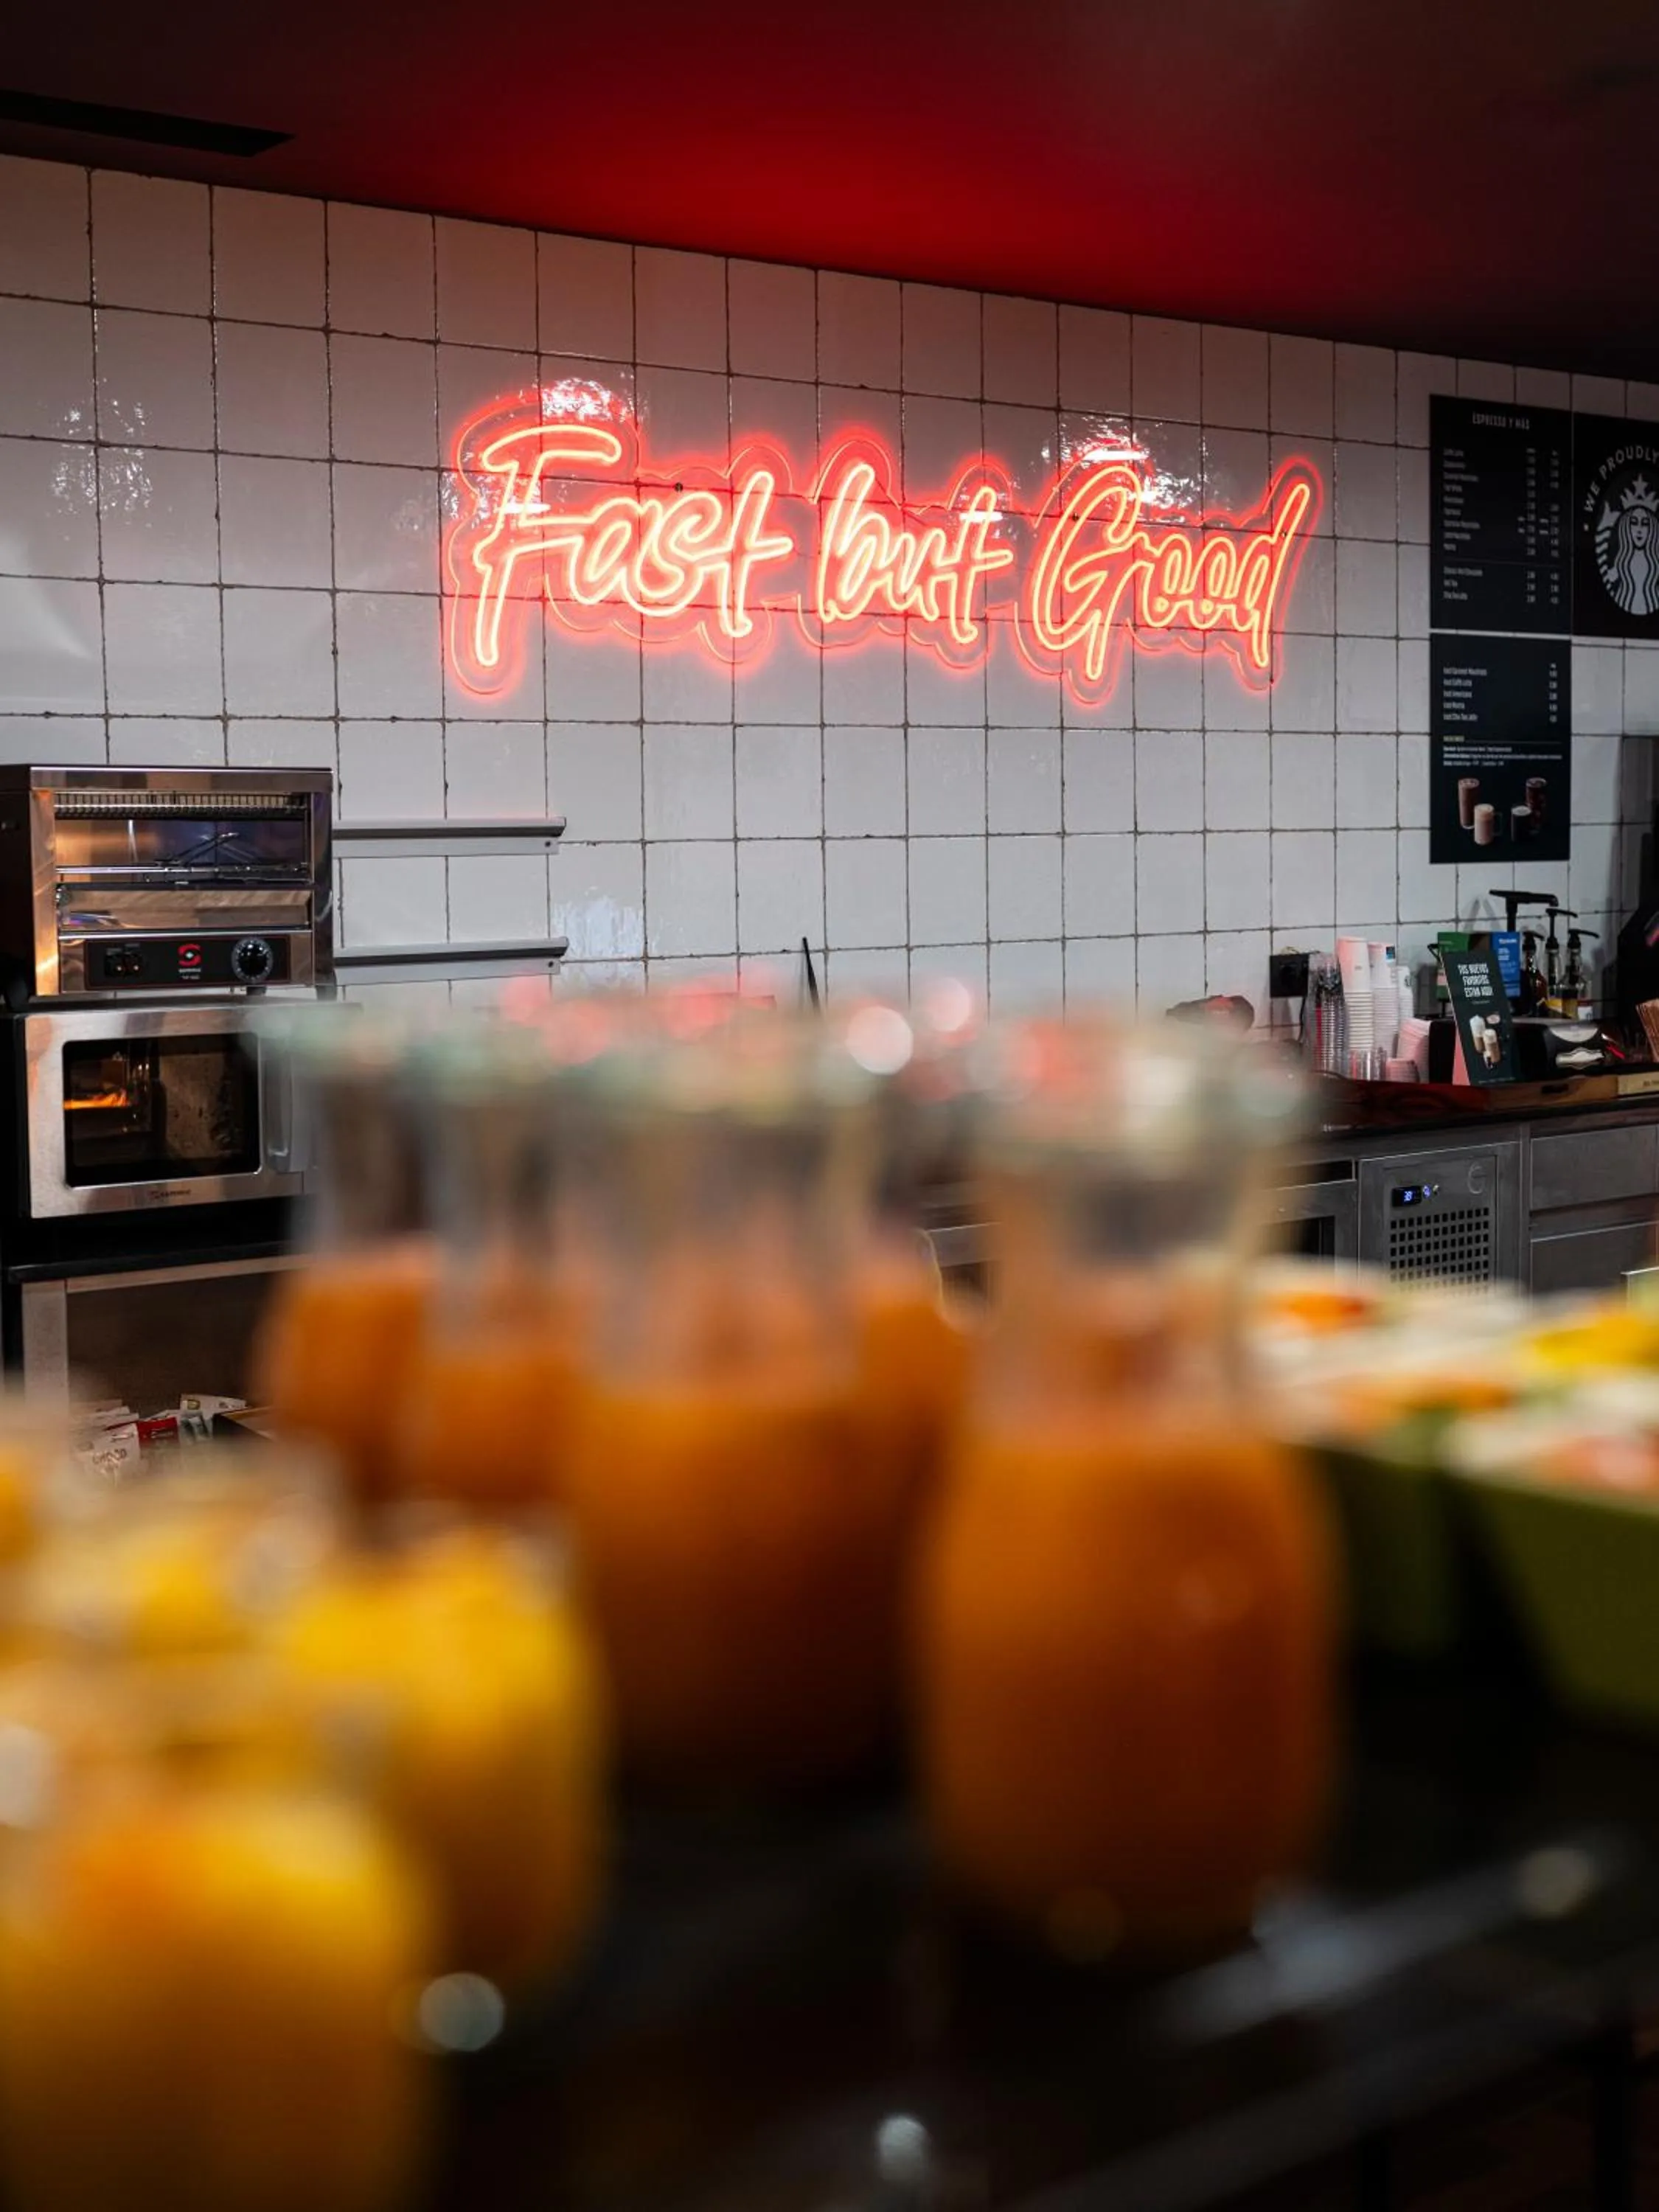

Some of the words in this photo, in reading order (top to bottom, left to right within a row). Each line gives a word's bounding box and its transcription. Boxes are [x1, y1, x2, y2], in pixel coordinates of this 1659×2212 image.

[473, 423, 794, 667] Fast
[817, 463, 1015, 644] but
[1032, 463, 1311, 681] Good
[1584, 481, 1601, 512] WE
[1599, 445, 1659, 481] PROUDLY
